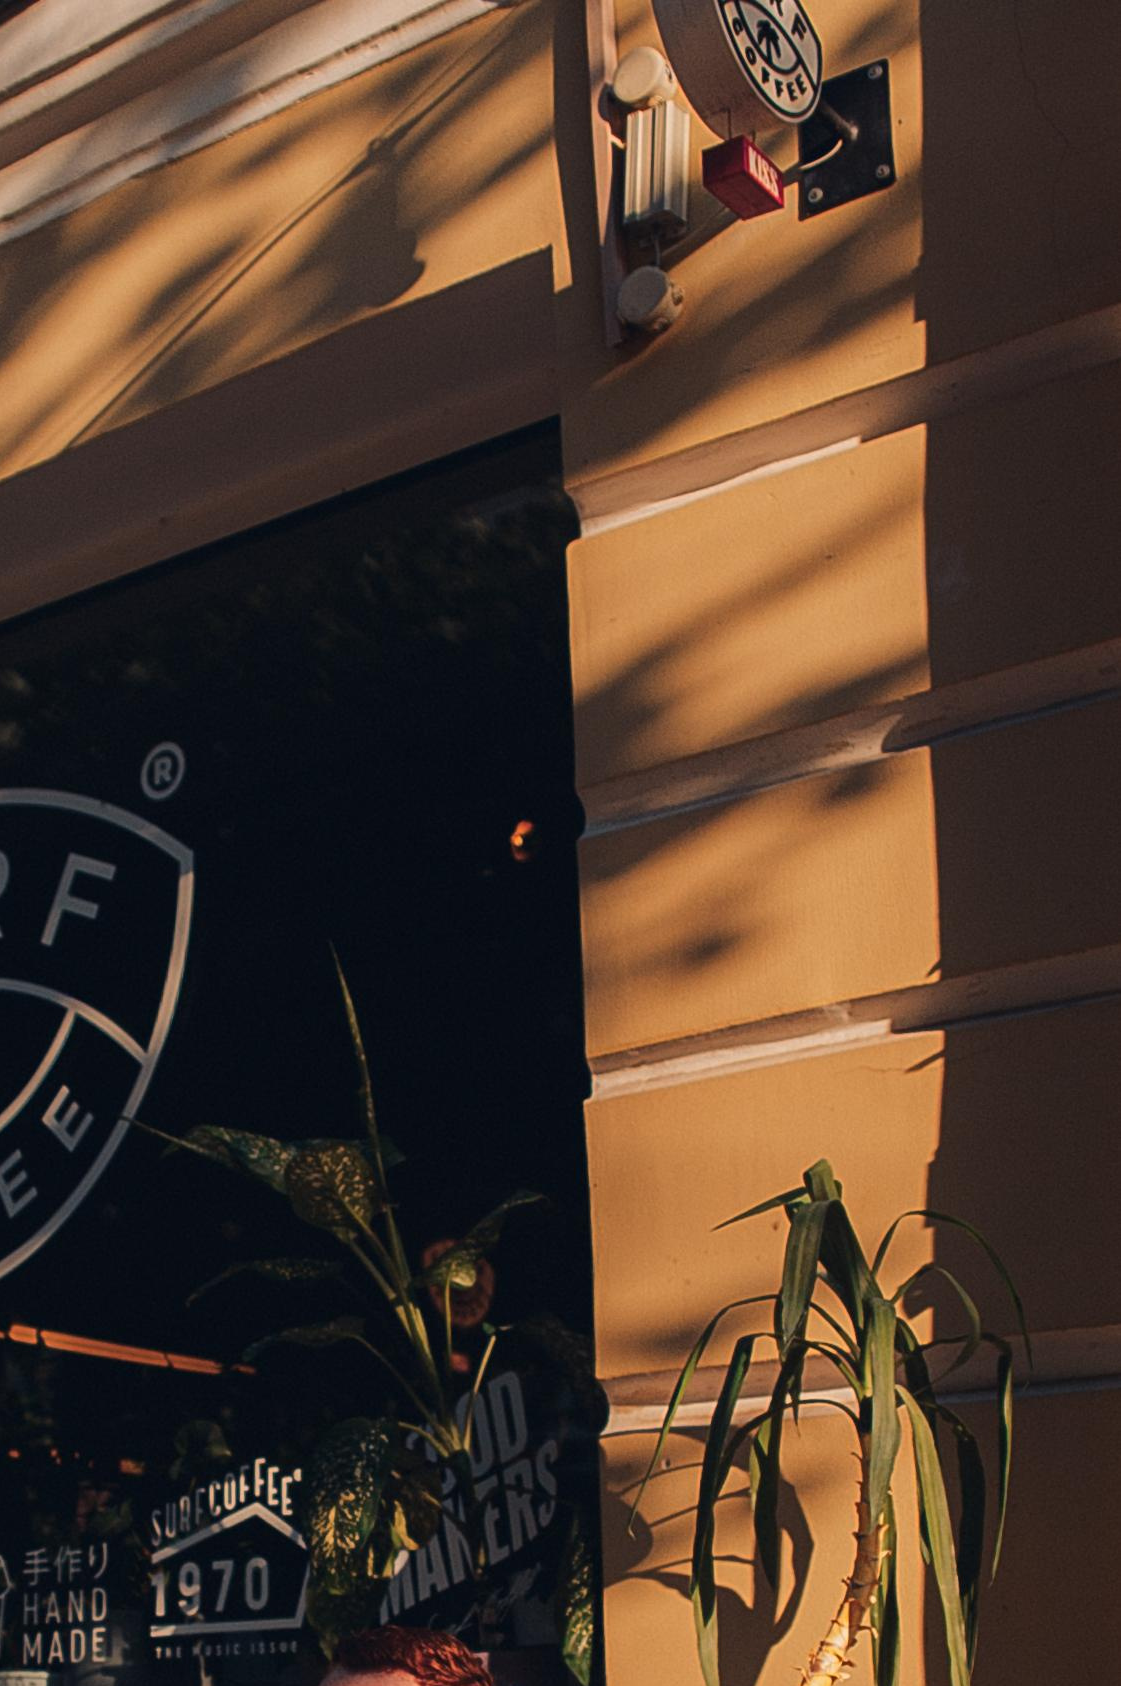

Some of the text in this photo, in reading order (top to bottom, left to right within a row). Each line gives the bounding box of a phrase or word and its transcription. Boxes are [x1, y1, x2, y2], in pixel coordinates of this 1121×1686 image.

[747, 144, 780, 197] KISS
[22, 1541, 109, 1586] 手作り
[22, 1587, 108, 1626] HAND
[148, 1556, 269, 1617] 1970
[22, 1626, 107, 1665] MADE
[250, 1640, 298, 1655] ISSUE
